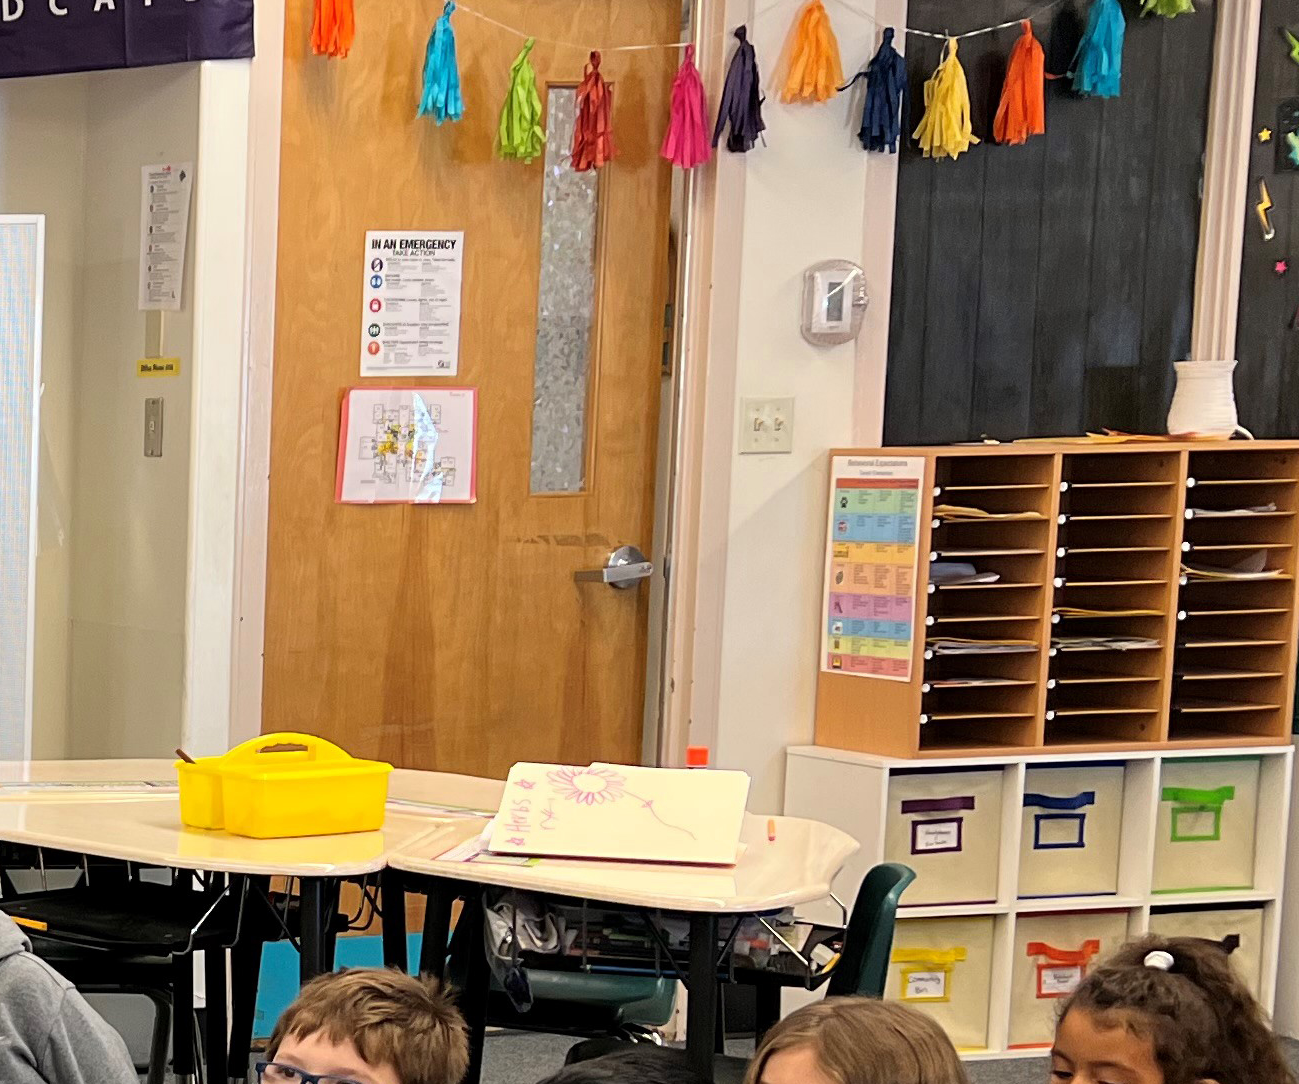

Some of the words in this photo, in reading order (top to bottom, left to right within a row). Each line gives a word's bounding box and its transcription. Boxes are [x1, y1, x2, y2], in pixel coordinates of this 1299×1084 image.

[371, 239, 381, 249] IN
[383, 239, 396, 249] AN
[399, 239, 457, 250] EMERGENCY
[410, 249, 436, 257] ACTION
[504, 799, 532, 833] Herbs
